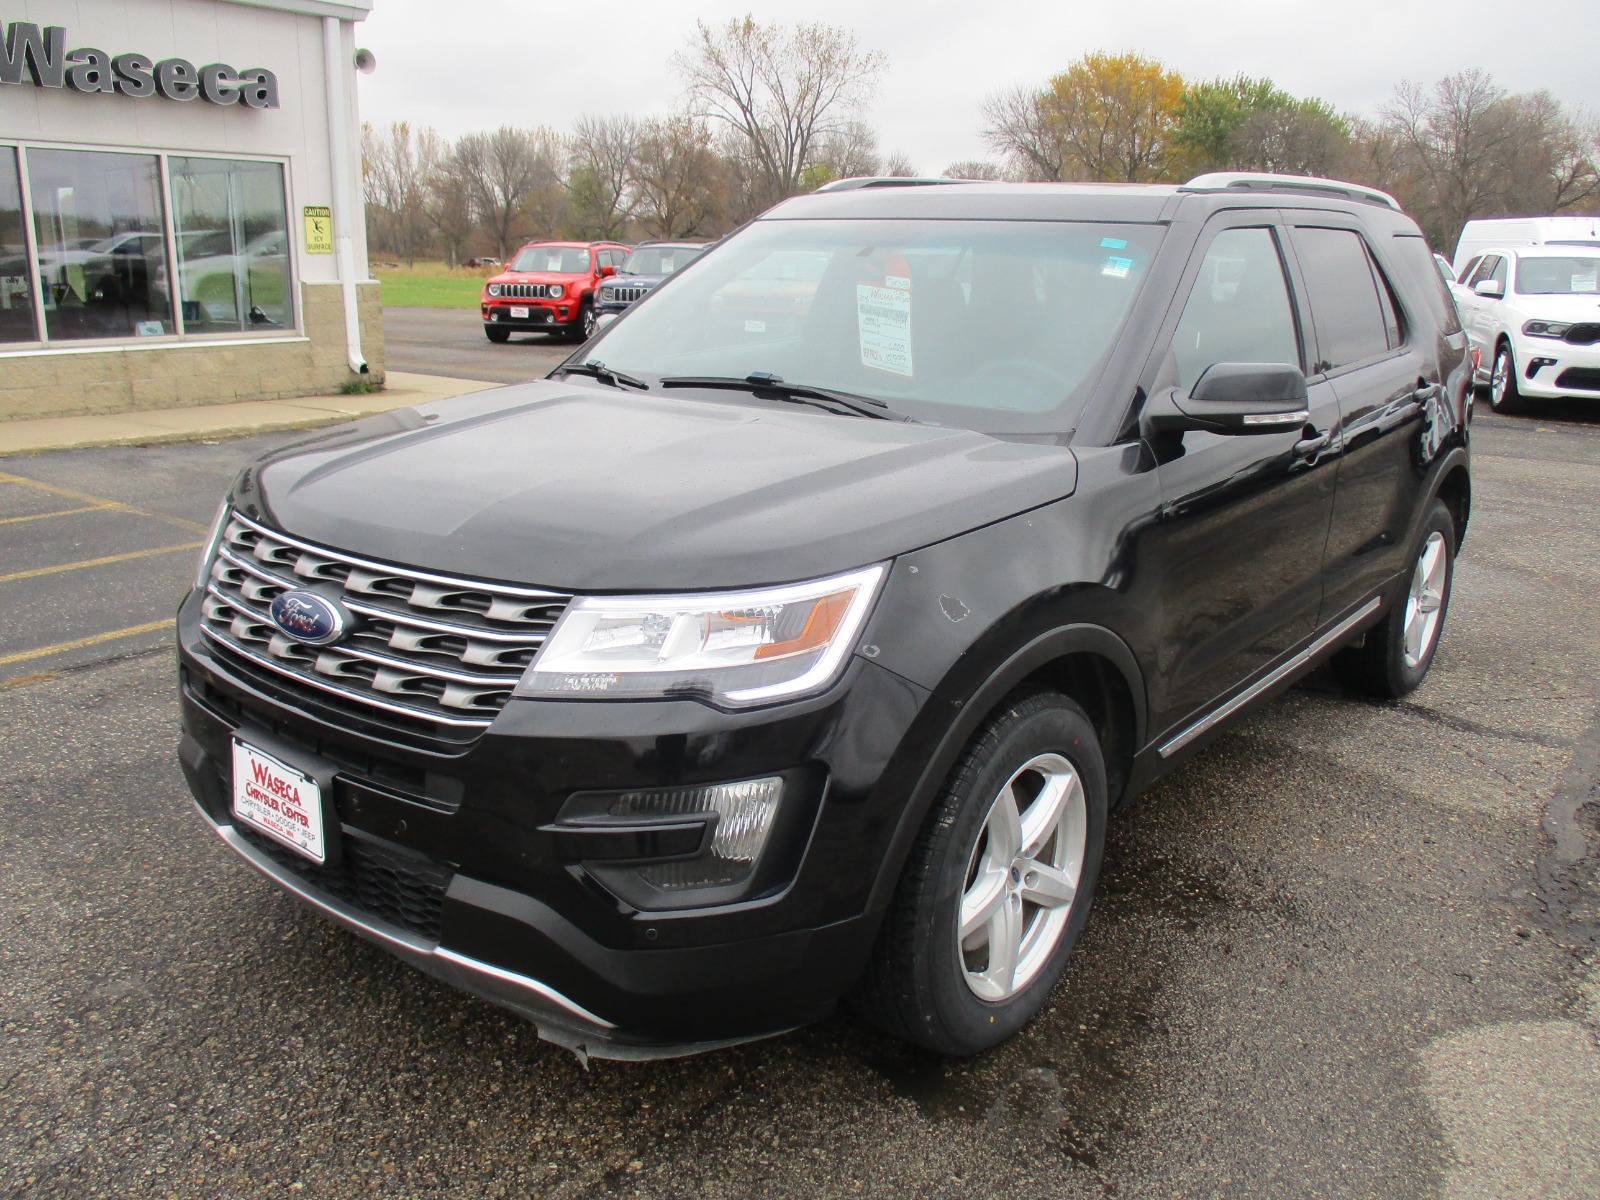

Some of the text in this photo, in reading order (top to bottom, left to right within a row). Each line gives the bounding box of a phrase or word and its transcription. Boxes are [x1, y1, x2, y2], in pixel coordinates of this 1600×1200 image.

[0, 20, 280, 109] Waseca
[304, 207, 330, 216] CAUTION
[279, 598, 319, 633] Ford
[245, 782, 310, 828] CHRYSLER CENTER
[251, 758, 301, 807] WASECA
[241, 795, 316, 841] CHRYSLER DODGE JEEP
[285, 827, 295, 838] MN
